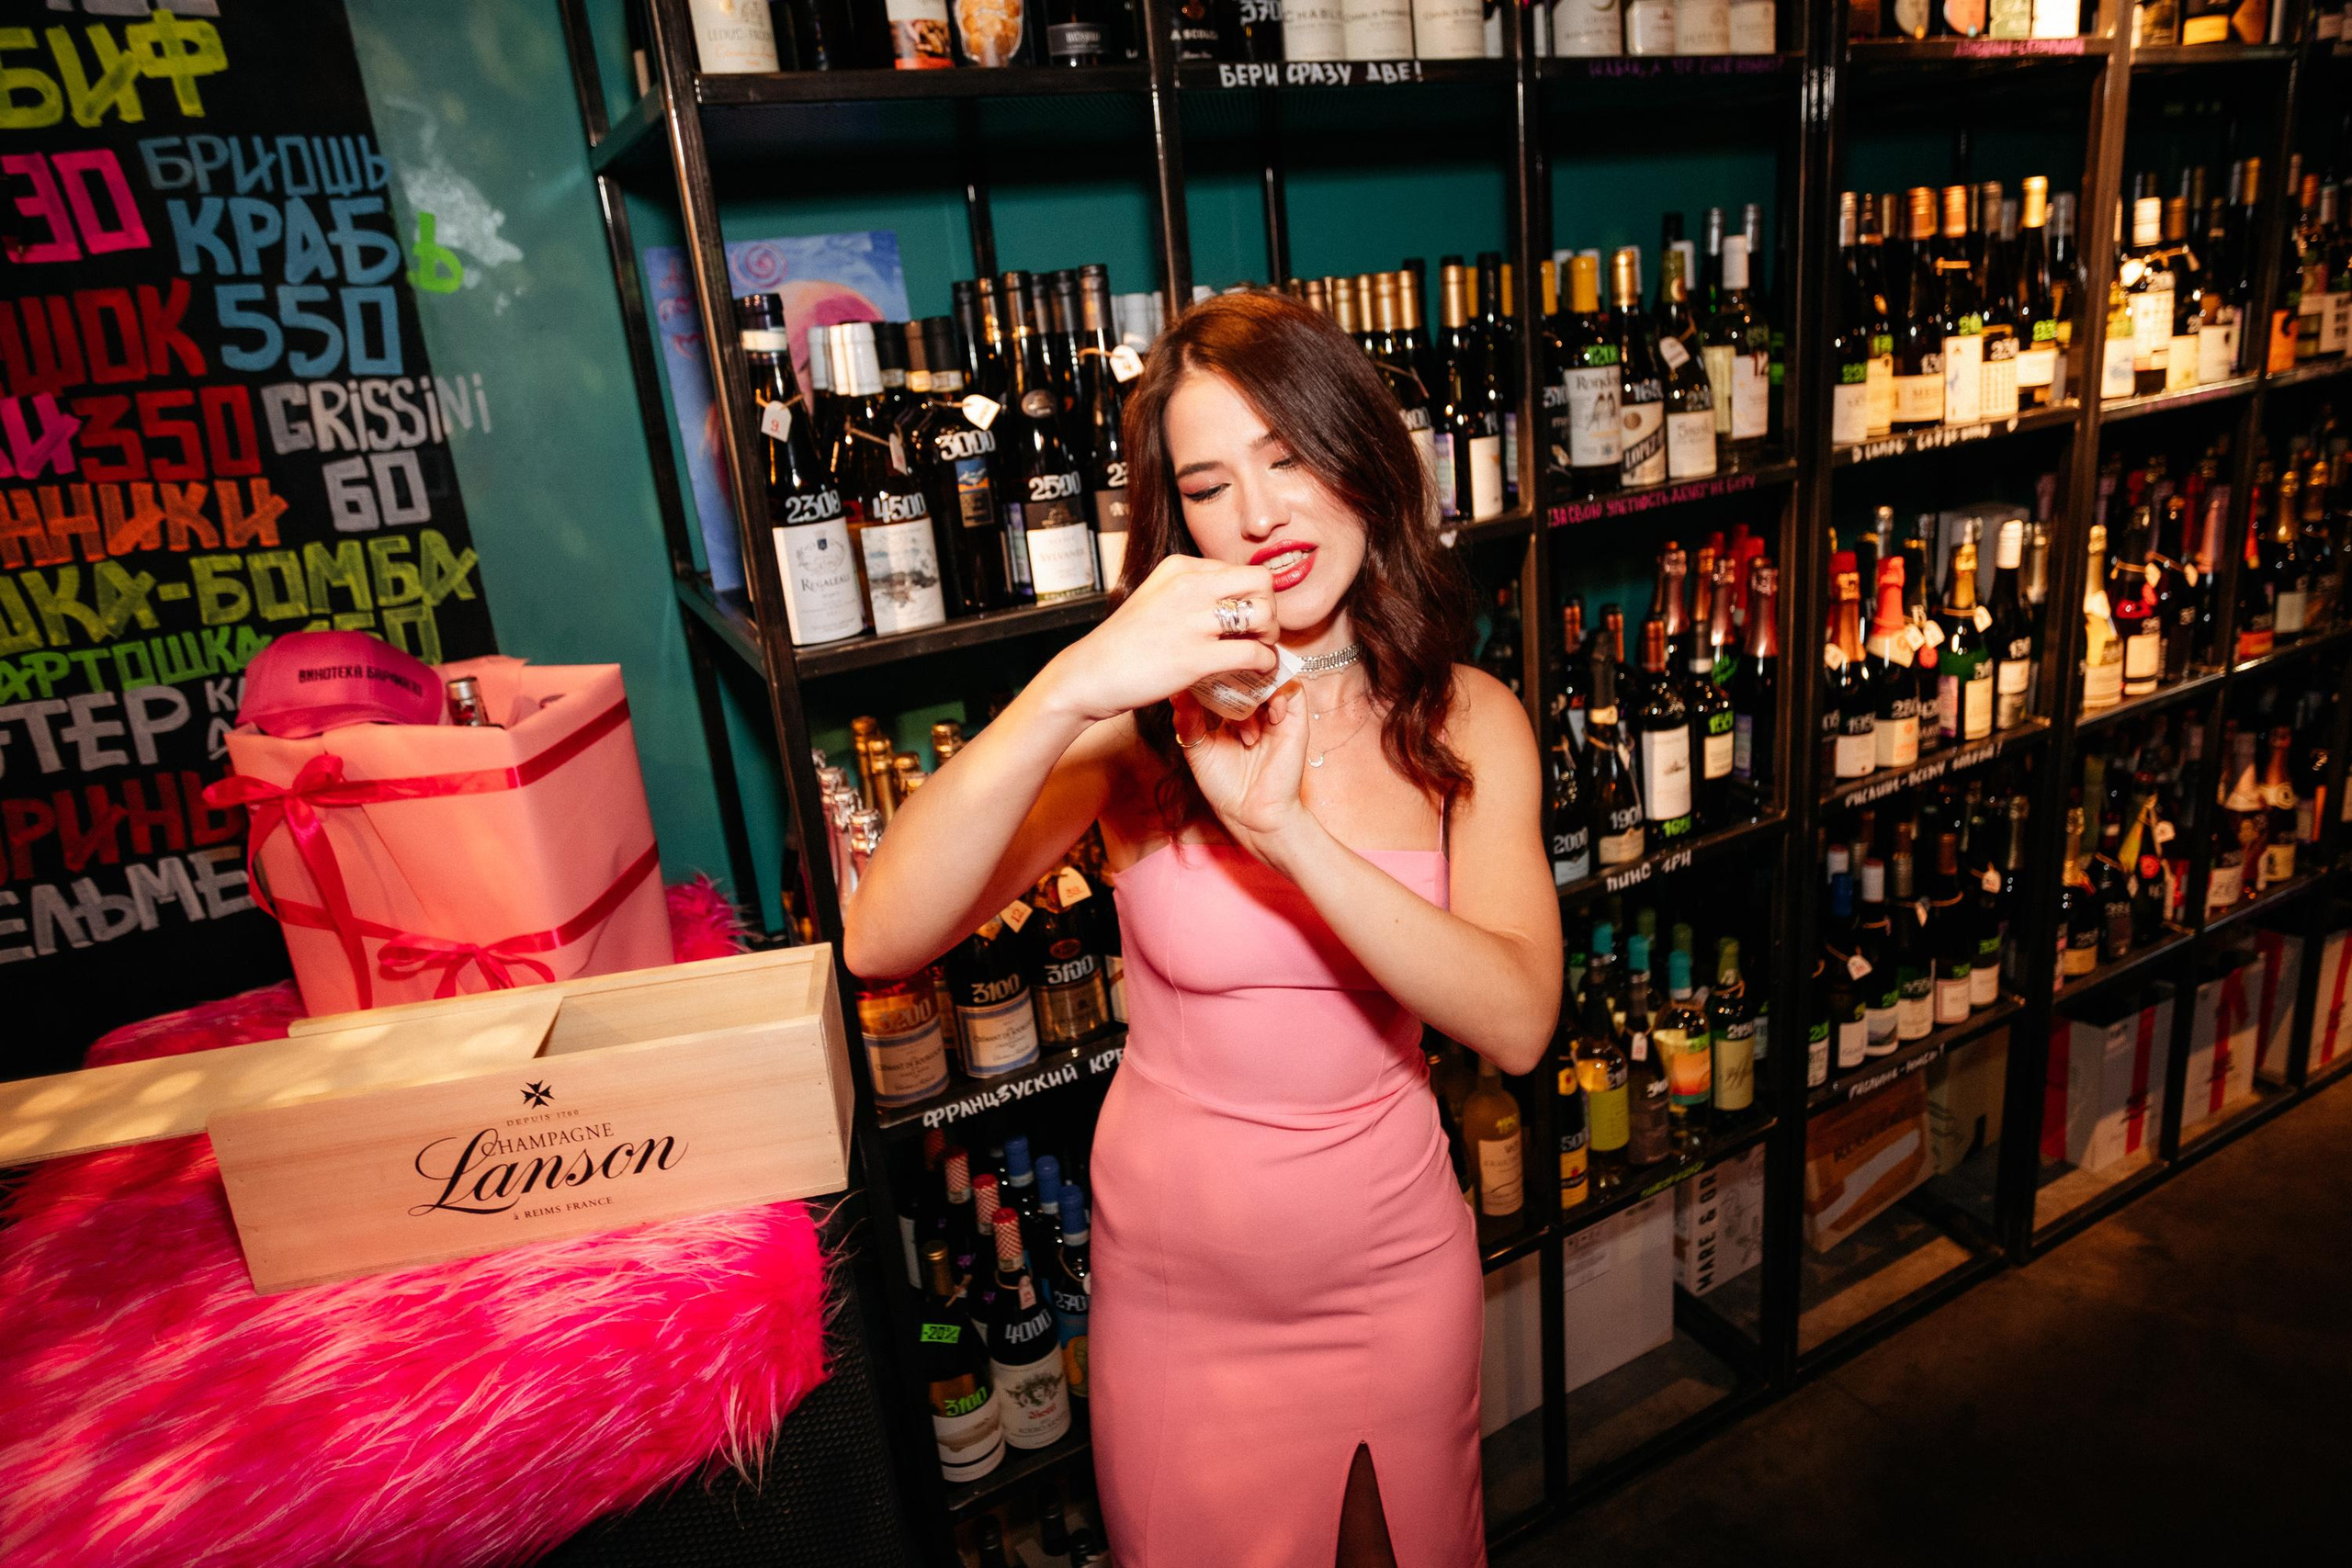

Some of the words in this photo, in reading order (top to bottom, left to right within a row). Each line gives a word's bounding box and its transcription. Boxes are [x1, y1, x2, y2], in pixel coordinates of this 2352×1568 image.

[1220, 62, 1279, 88] БЕРИ
[1286, 62, 1352, 86] СРАЗУ
[1365, 60, 1424, 83] ДВЕ!
[138, 134, 393, 197] БРИОШЬ
[165, 196, 402, 285] КРАБ
[213, 282, 404, 378] 550
[72, 384, 264, 484] 350
[939, 429, 997, 462] 3000
[322, 449, 432, 532] 60
[1028, 470, 1082, 502] 2500
[873, 491, 926, 525] 4500
[298, 664, 363, 684] ВИНОТЕКА
[1045, 953, 1094, 985] 3100
[970, 973, 1020, 1004] 3100
[506, 1112, 551, 1128] DEPUIS
[556, 1109, 581, 1121] 1760
[481, 1122, 616, 1158] CHAMPAGNE
[408, 1127, 690, 1218] Lanson
[525, 1204, 563, 1220] REIMS
[565, 1196, 615, 1212] FRANCE
[1004, 1307, 1053, 1345] 4000
[944, 1385, 989, 1418] 3100
